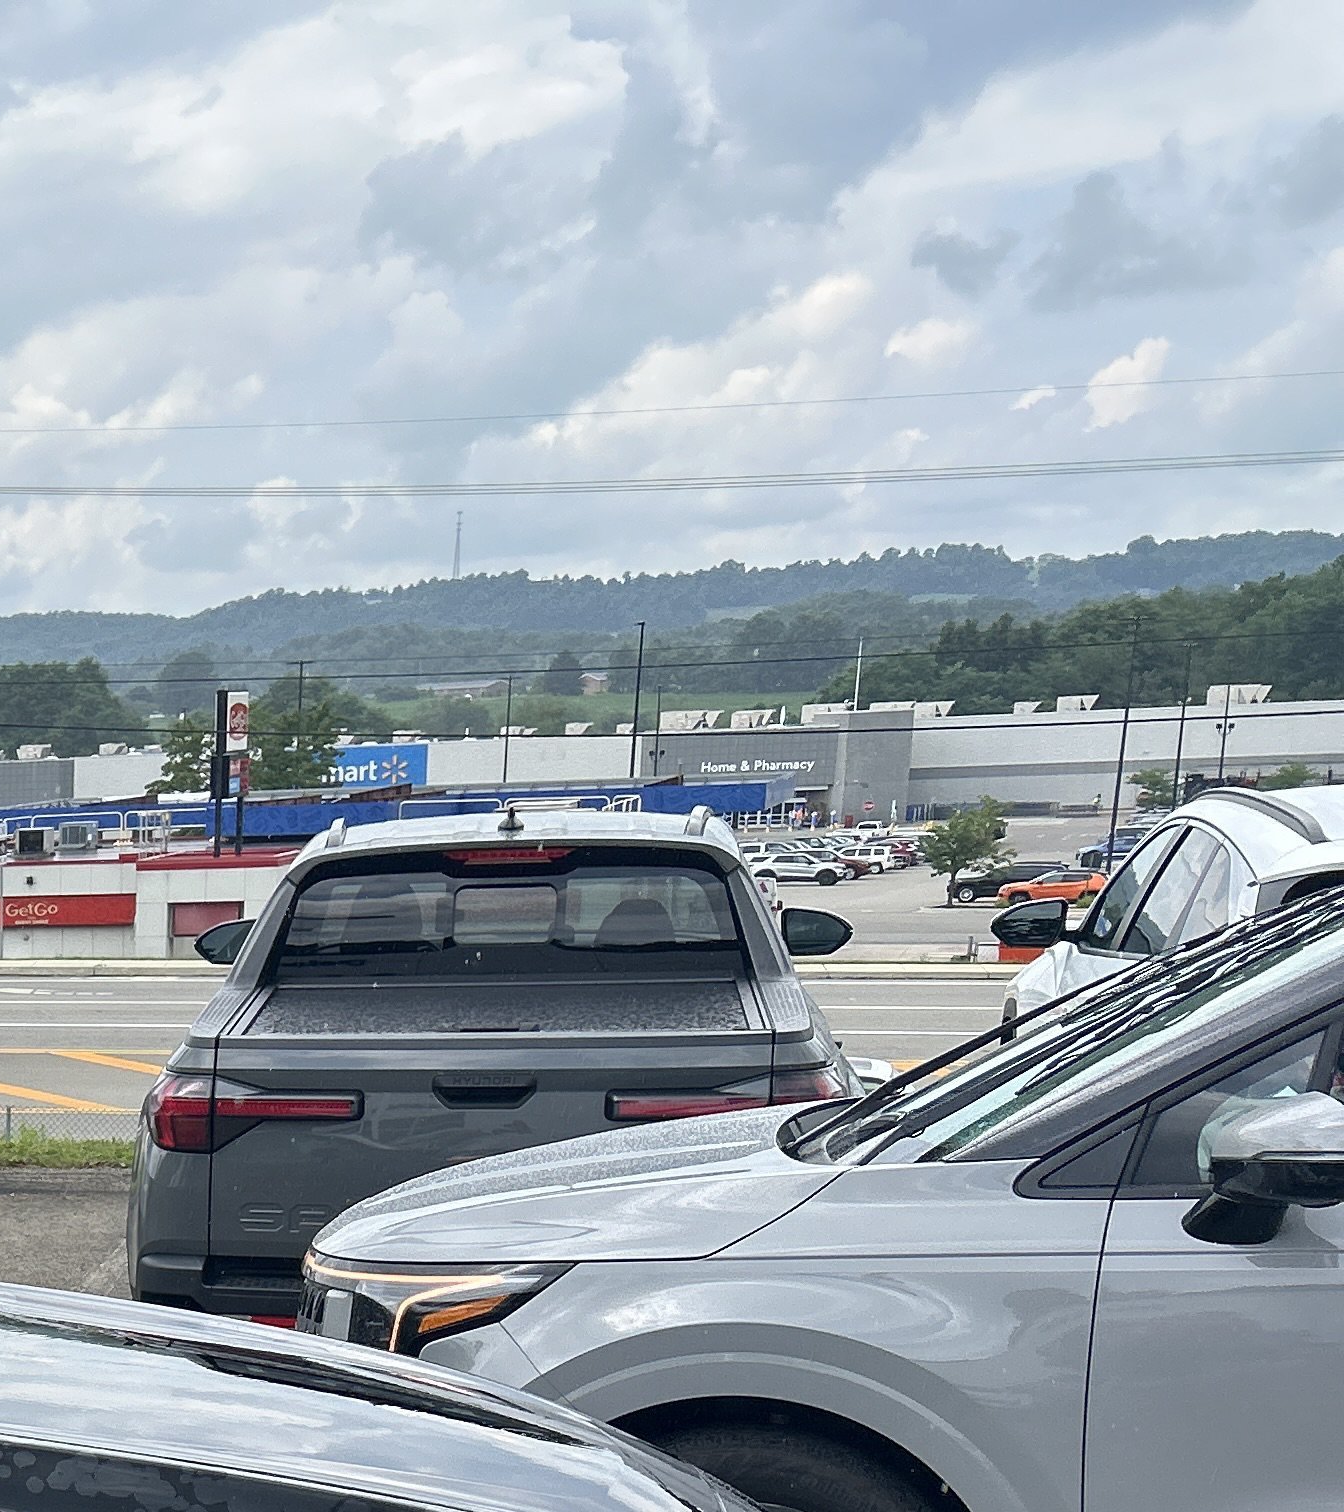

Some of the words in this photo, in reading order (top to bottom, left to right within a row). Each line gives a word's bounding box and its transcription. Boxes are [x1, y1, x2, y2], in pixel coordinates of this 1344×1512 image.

[700, 761, 737, 773] Home
[740, 760, 750, 771] &
[753, 759, 816, 773] Pharmacy
[5, 902, 58, 917] GetGo
